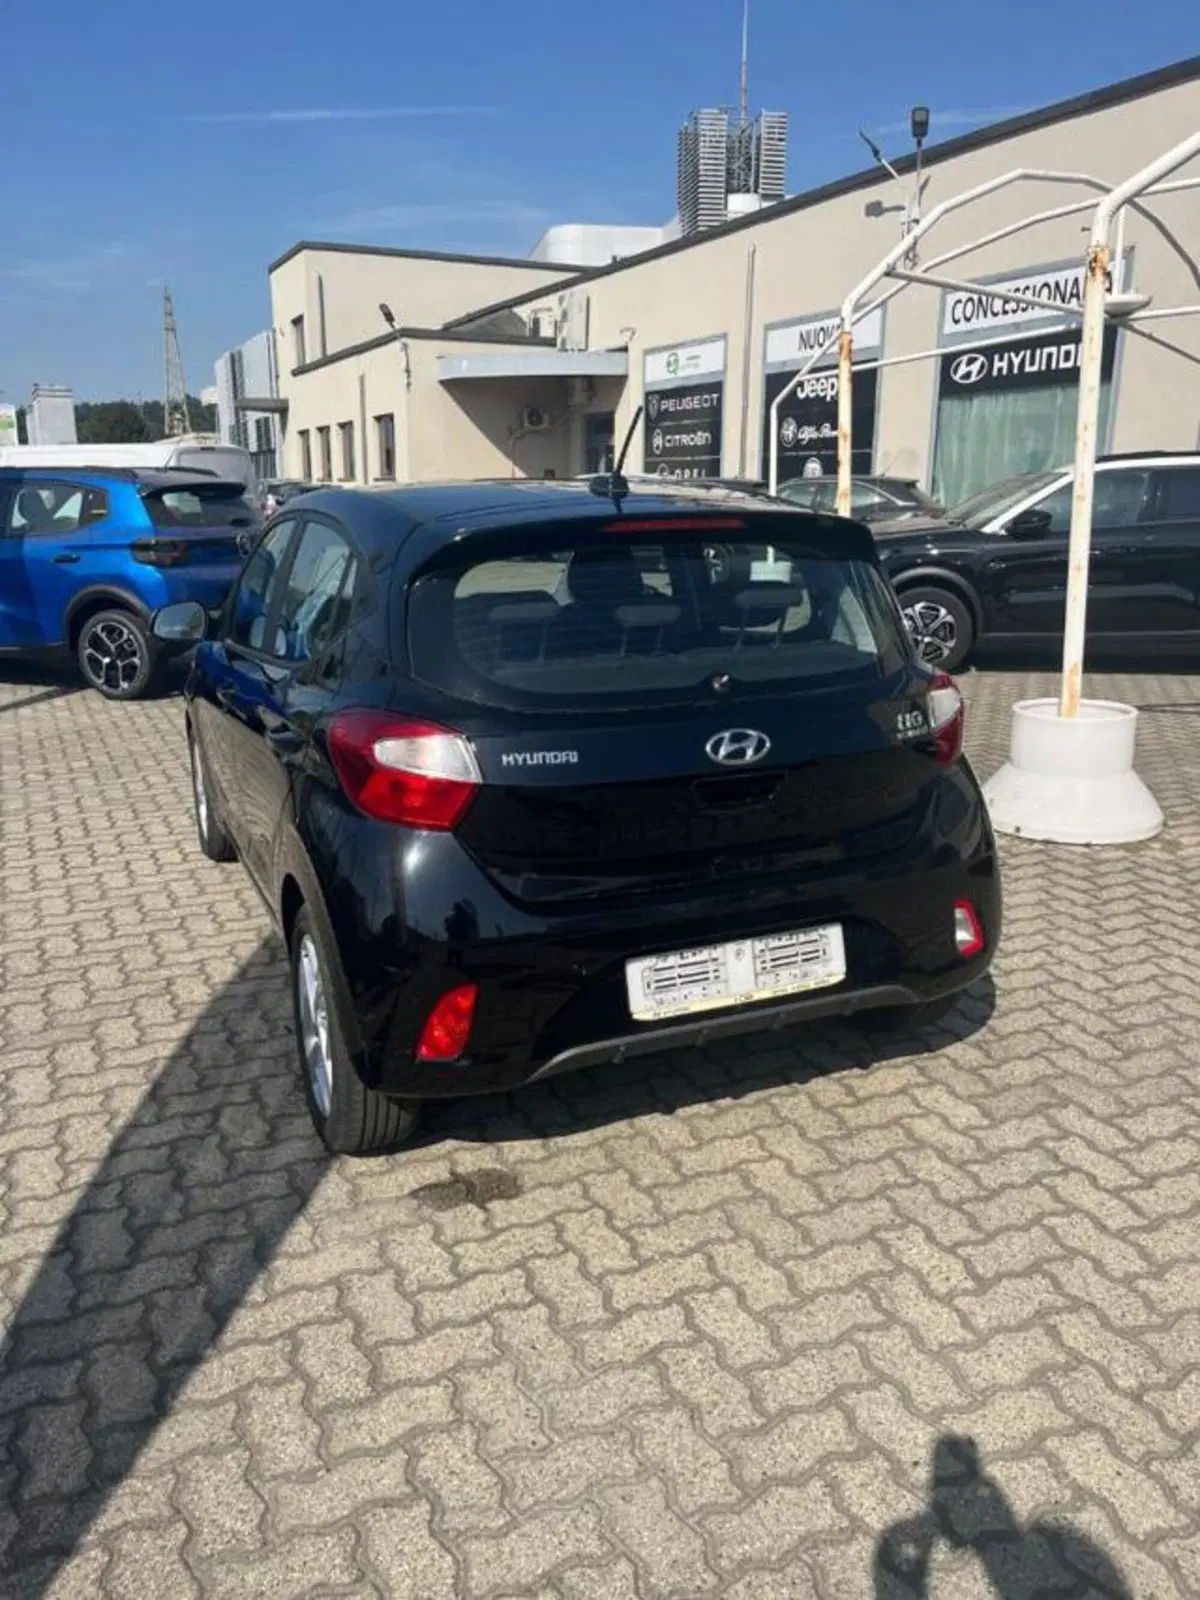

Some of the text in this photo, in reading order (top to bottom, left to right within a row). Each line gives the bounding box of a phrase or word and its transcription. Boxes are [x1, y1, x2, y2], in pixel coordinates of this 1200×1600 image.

[951, 275, 1083, 325] CONCESSIONA
[991, 343, 1082, 377] HYUND
[797, 376, 838, 401] Jeep
[660, 393, 719, 412] PEUGEOT
[501, 751, 578, 766] HYUNDAI
